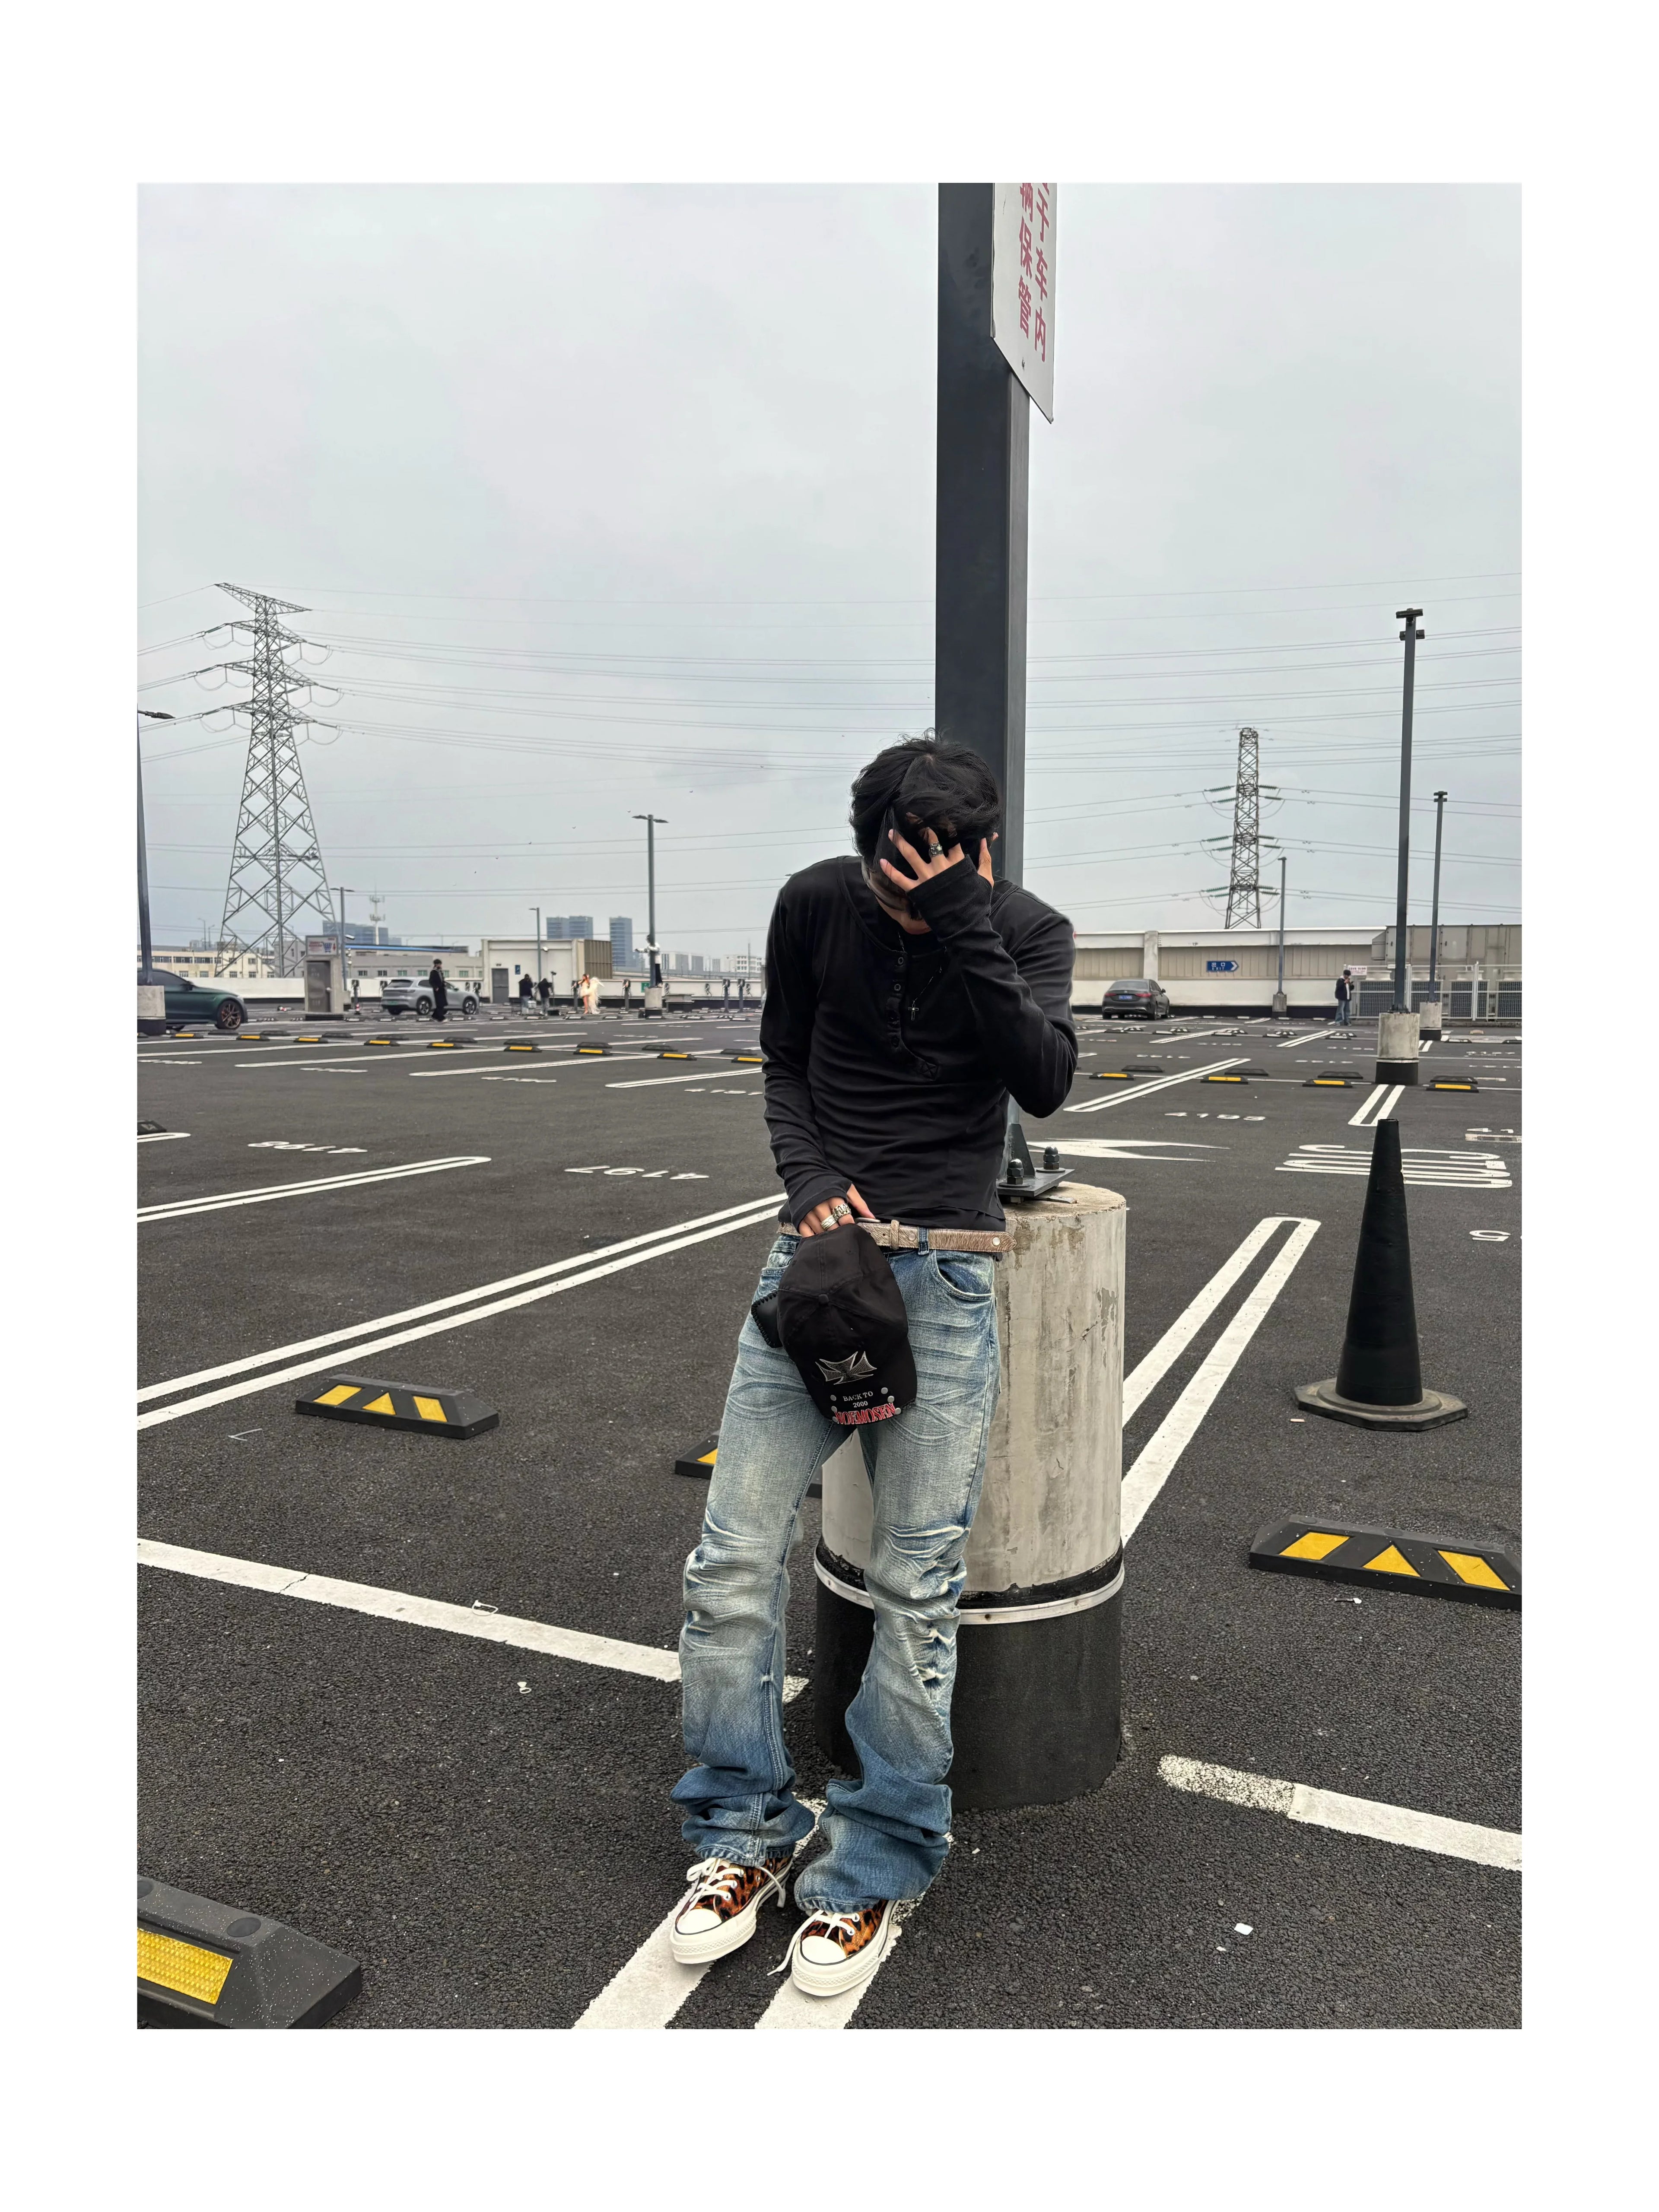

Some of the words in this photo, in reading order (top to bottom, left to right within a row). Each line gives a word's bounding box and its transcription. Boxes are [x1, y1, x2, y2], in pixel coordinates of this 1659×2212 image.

[1034, 183, 1049, 362] 于车内
[564, 1165, 709, 1180] 4197
[1469, 1230, 1522, 1242] 5
